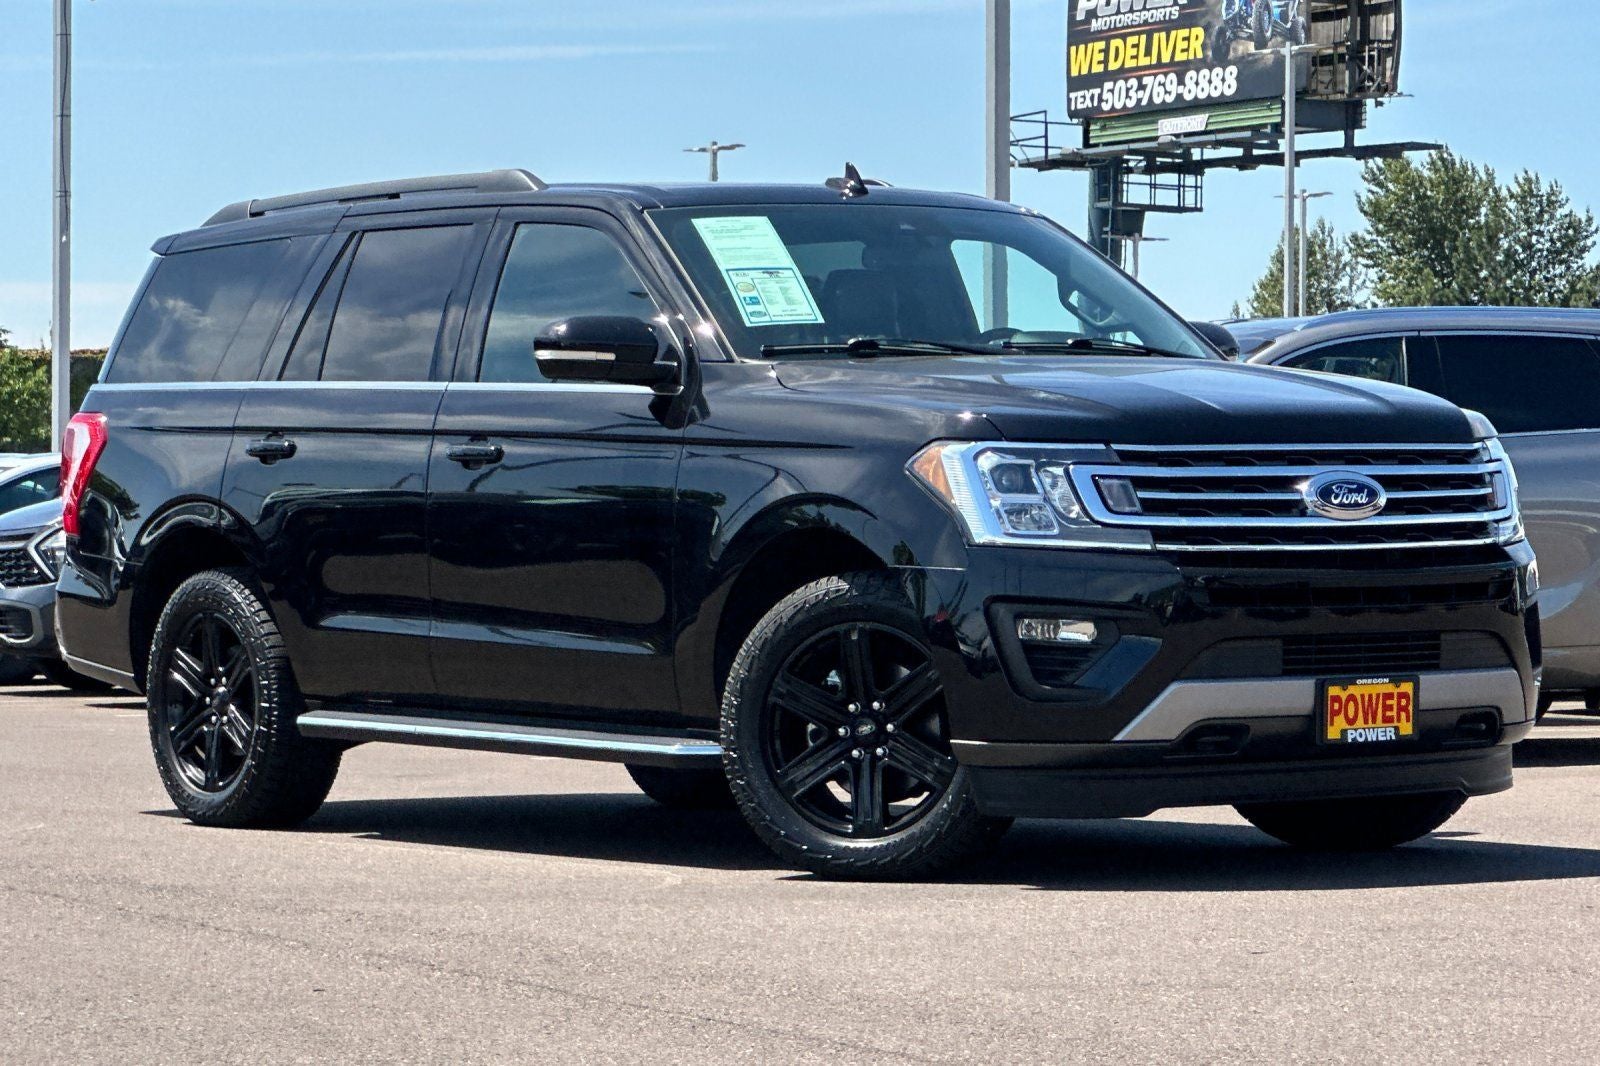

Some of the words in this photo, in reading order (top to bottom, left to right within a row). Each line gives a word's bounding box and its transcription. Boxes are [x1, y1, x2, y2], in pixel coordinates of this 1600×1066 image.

[1075, 0, 1187, 20] POW
[1090, 6, 1180, 32] MOTORSPORTS
[1070, 40, 1105, 77] WE
[1107, 27, 1204, 71] DELIVER
[1069, 88, 1101, 111] TEXT
[1101, 65, 1238, 111] 503-769-8888
[1331, 483, 1368, 504] Ford
[1329, 691, 1411, 727] POWER
[1347, 727, 1396, 743] POWER
